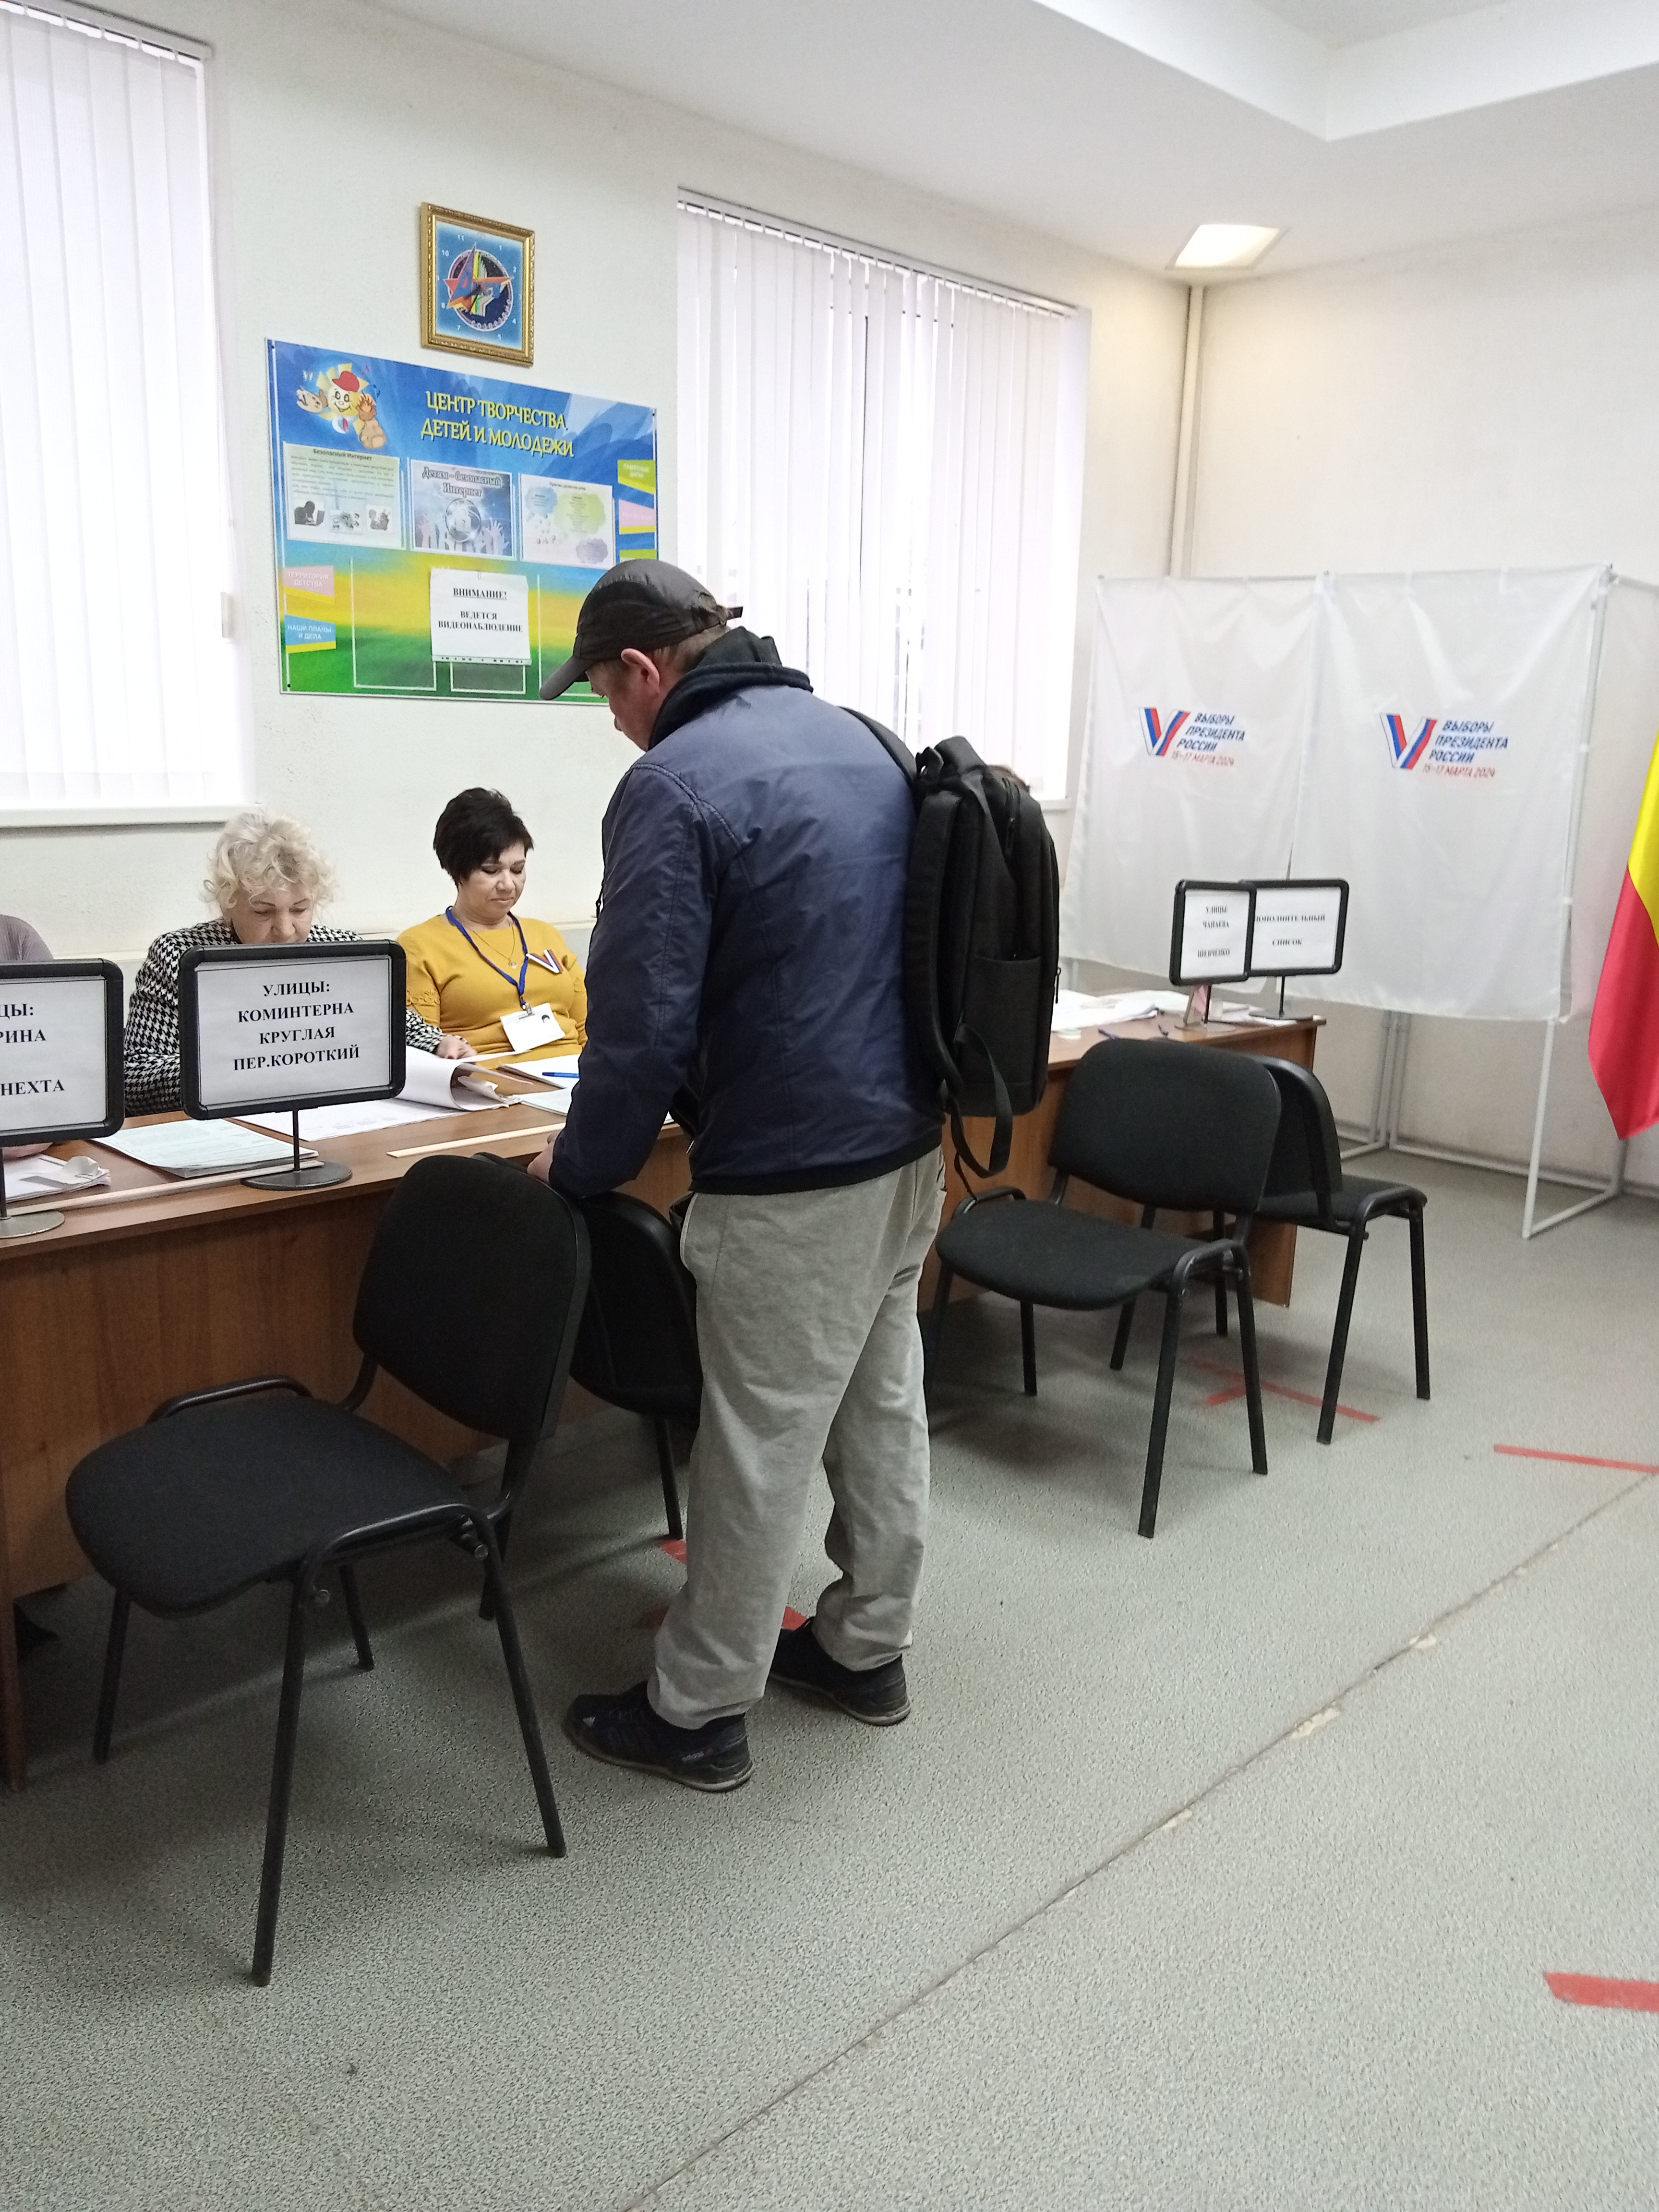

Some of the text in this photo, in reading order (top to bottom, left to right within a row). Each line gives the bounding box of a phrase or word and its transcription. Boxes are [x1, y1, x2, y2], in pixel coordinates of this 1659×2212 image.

[426, 391, 476, 414] ЦЕНТР
[421, 418, 575, 457] ДЕТЕЙ И МОЛОДЕЖИ
[313, 448, 372, 461] Безопасный Интернет
[422, 467, 449, 480] Детям
[443, 482, 482, 497] Интернет
[288, 571, 329, 580] ТЕРРИТОРИЯ
[294, 579, 323, 588] ДЕТСТВА
[453, 588, 507, 599] ВНИМАНИЕ!
[460, 611, 497, 620] ВЕДЕТСЯ
[438, 621, 523, 632] ВИДЕОНАБЛЮДЕНИЕ
[1194, 712, 1235, 725] ВЫБОРЫ
[1443, 720, 1494, 733] ВЫБОРЫ
[1185, 725, 1246, 742] ПРЕЗИДЕНТА
[1177, 738, 1218, 752] РОССИИ
[1435, 734, 1508, 749] ПРЕЗИДЕНТА
[1192, 753, 1215, 765] МАРТА
[1429, 749, 1475, 764] РОССИИ
[1445, 767, 1472, 777] МАРТА
[1203, 920, 1229, 929] ЧАПАЕВА
[1272, 938, 1302, 947] СПИСОК
[1198, 949, 1230, 958] ШЕВЧЕНКО
[262, 981, 330, 997] УЛИЦЫ:
[238, 1002, 354, 1022] КОМИНТЕРНА
[259, 1026, 335, 1045] КРУГЛАЯ
[233, 1044, 360, 1070] ПЕР.КОРОТКИЙ
